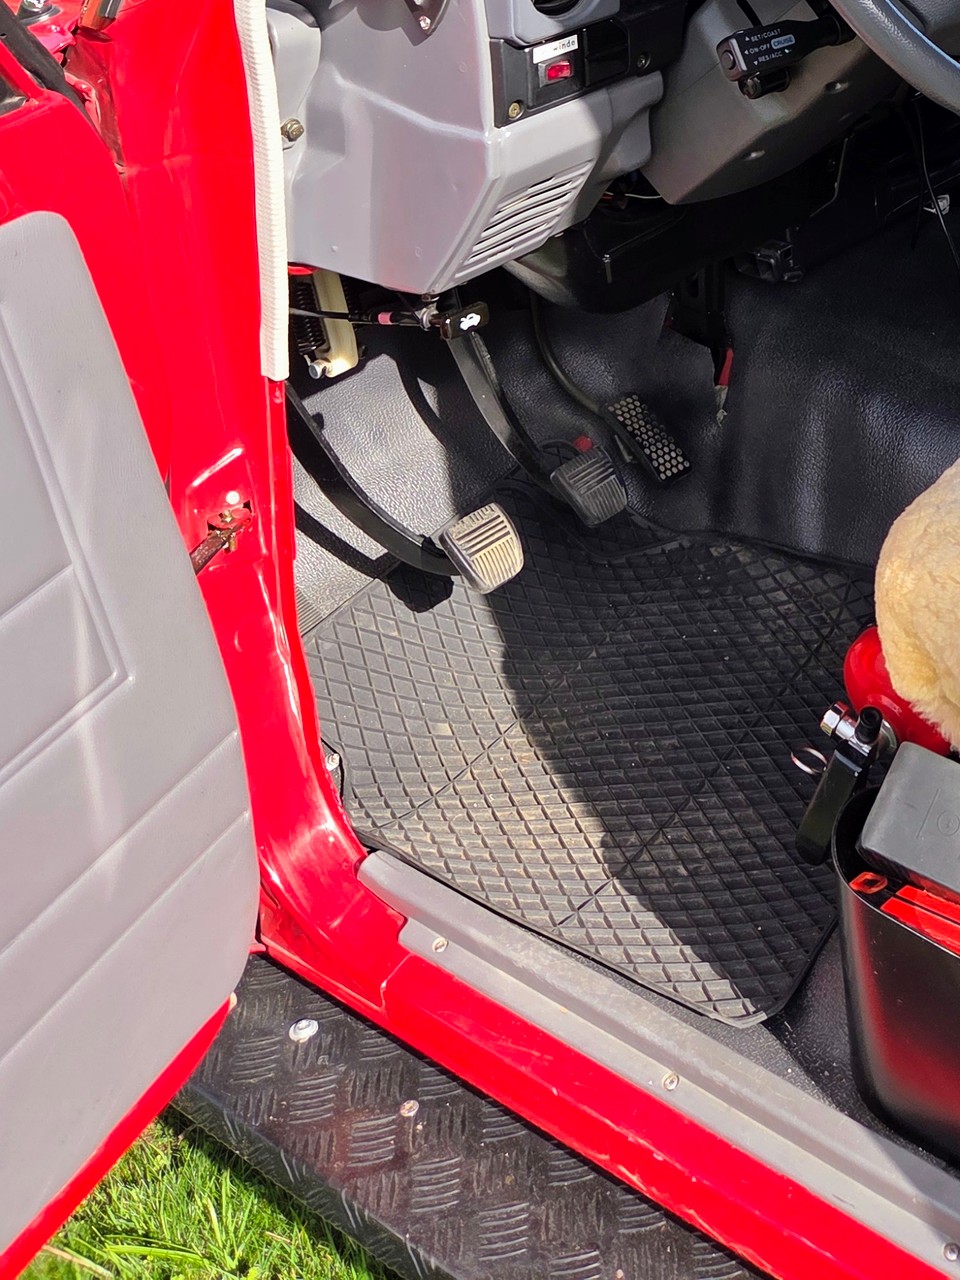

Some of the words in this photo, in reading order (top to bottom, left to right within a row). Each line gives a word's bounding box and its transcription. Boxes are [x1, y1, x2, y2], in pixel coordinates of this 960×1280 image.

[751, 28, 781, 42] SET/COAST
[749, 43, 770, 54] ON-OFF
[758, 51, 783, 62] RES/ACC
